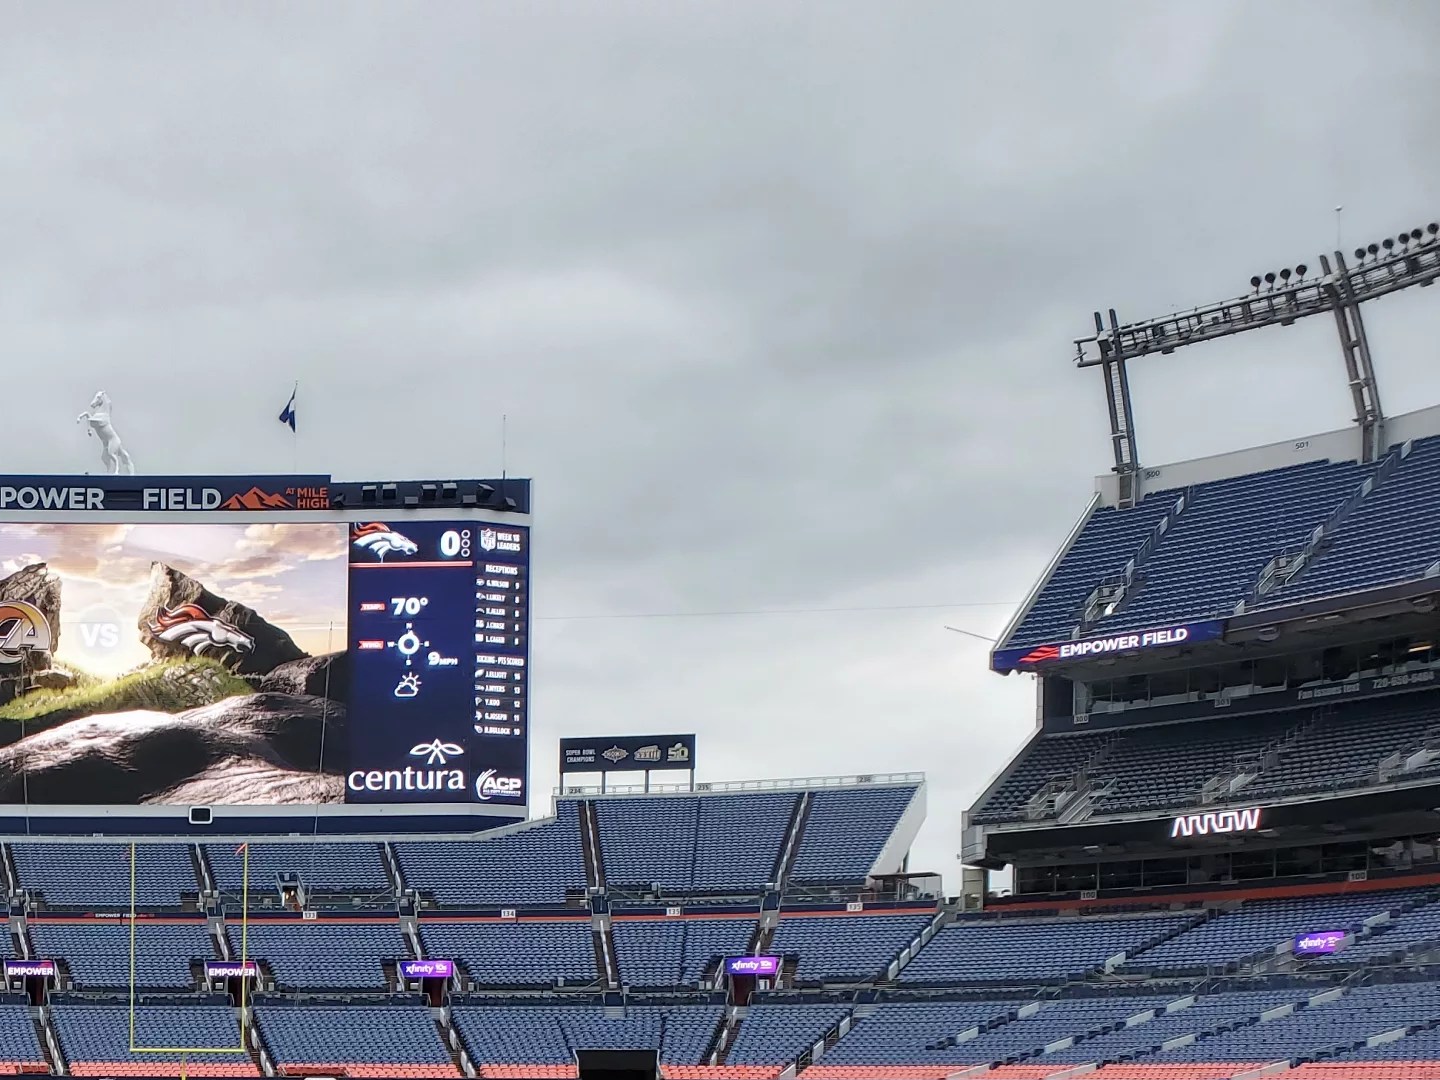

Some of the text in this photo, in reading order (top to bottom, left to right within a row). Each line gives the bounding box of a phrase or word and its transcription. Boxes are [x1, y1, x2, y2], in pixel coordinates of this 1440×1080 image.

[1295, 440, 1310, 450] 501
[1145, 469, 1161, 479] 500
[143, 487, 222, 510] FIELD
[286, 487, 296, 495] AT
[297, 487, 328, 498] MILE
[297, 498, 330, 509] HIGH
[496, 532, 513, 541] WEEK
[440, 530, 460, 556] 0
[496, 541, 520, 551] LEADERS
[485, 564, 518, 575] RECEPTIONS
[80, 622, 119, 648] VS
[1060, 628, 1188, 658] EMPOWER FIELD
[348, 767, 466, 791] centura
[483, 777, 521, 791] ACP
[1171, 808, 1260, 838] ARROW
[1298, 937, 1327, 949] xfinity
[406, 963, 434, 974] xfinity
[731, 960, 759, 970] xfinity
[8, 967, 53, 976] EMPOWER
[209, 968, 255, 977] EMPOWER
